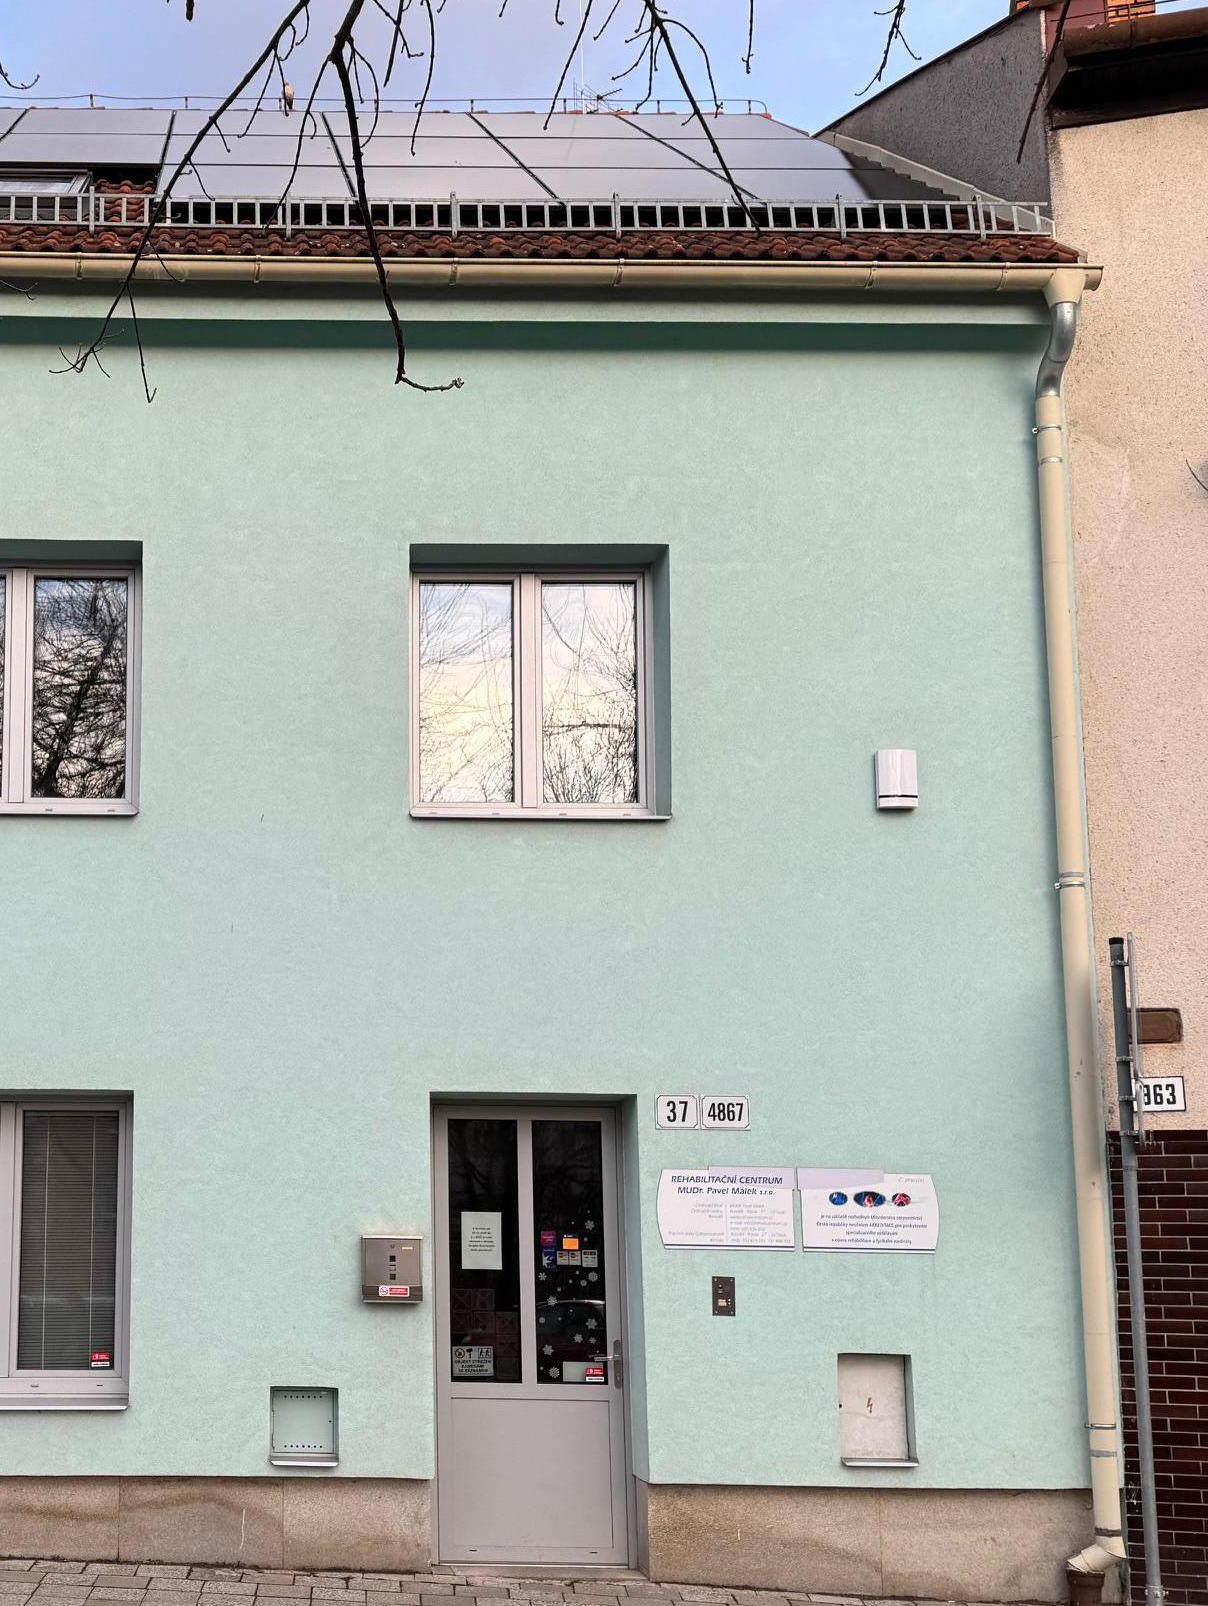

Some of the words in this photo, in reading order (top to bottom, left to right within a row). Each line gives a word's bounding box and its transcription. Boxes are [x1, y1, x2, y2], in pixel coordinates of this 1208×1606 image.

[666, 1100, 689, 1123] 37
[707, 1102, 744, 1122] 4867
[671, 1174, 737, 1184] REHABILITAČNÍ
[739, 1176, 783, 1185] CENTRUM
[677, 1186, 704, 1194] MUDr.
[706, 1187, 729, 1195] Pavel
